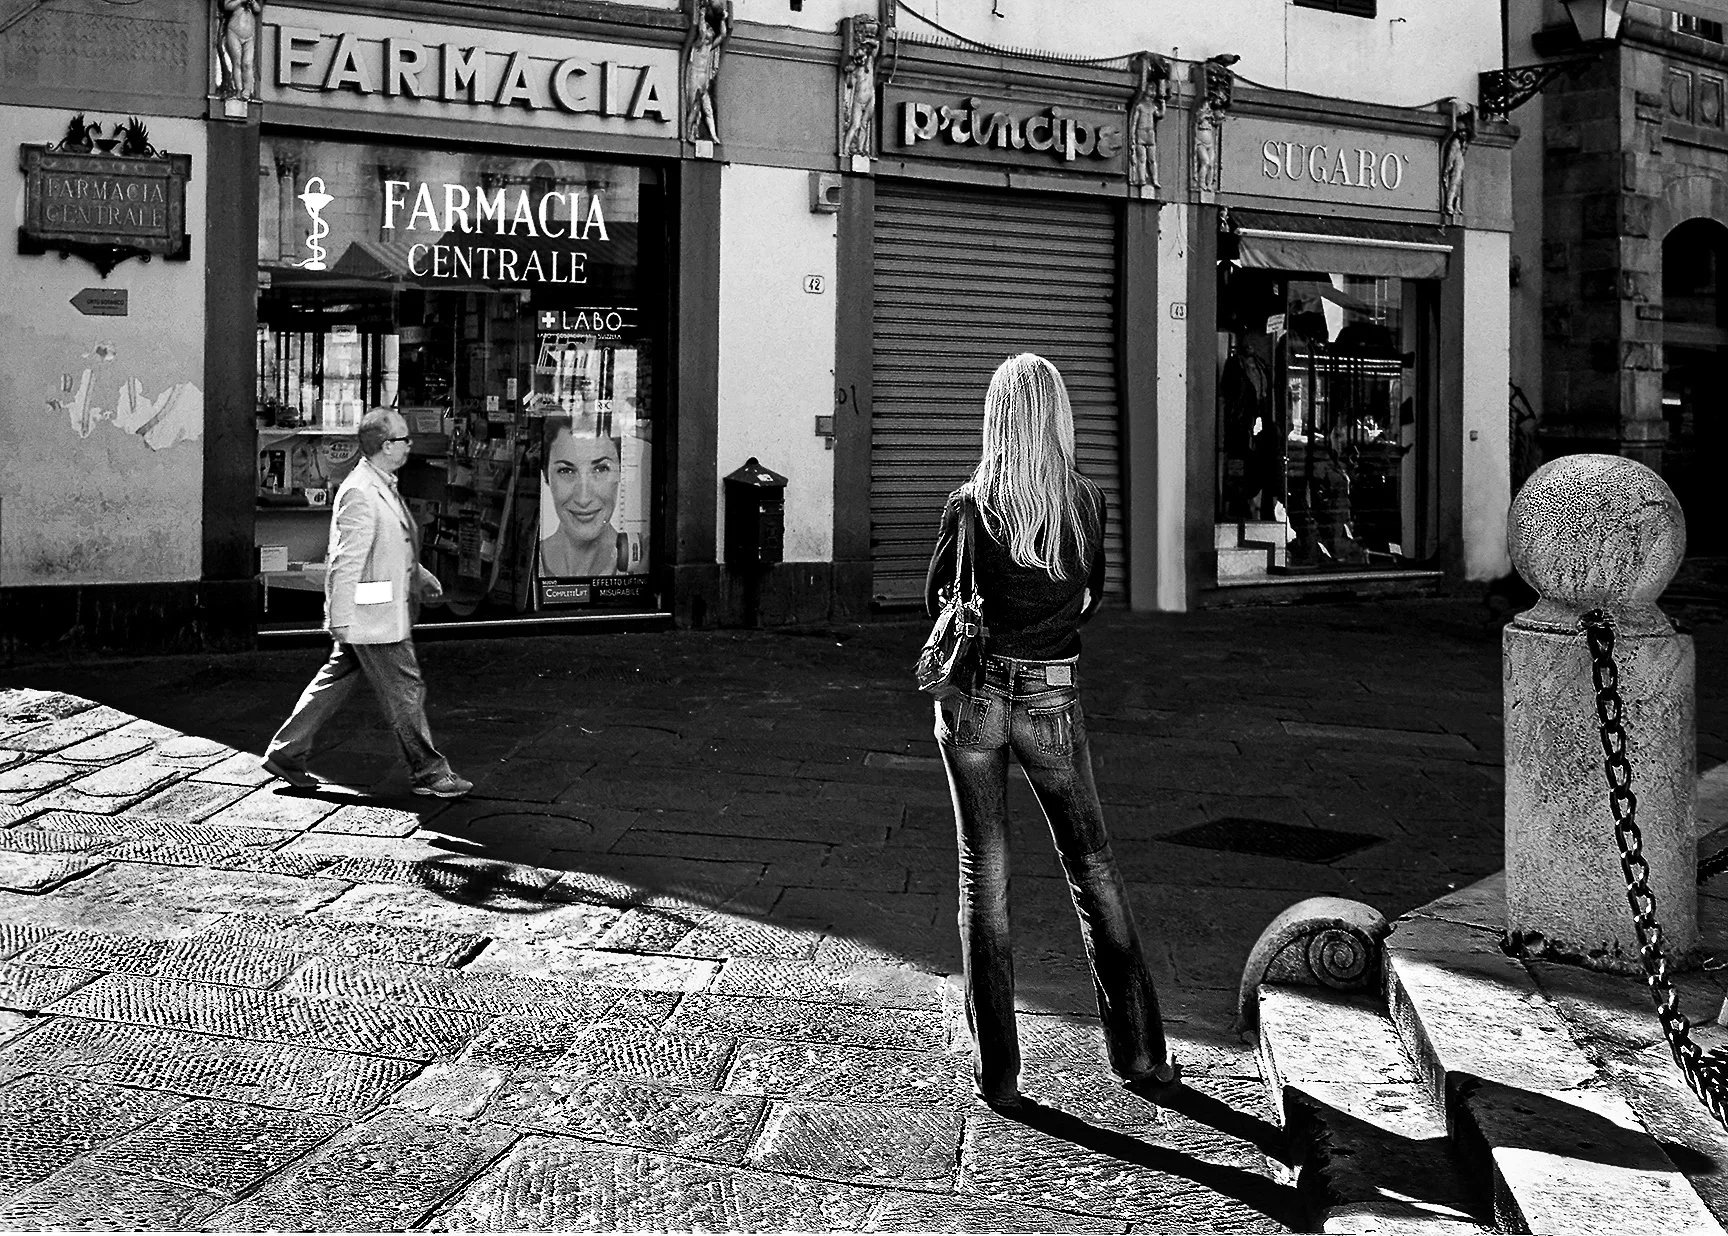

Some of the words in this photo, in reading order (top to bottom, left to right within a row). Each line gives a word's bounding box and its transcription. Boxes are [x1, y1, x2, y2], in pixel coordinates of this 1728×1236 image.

[276, 25, 671, 122] FARMACIA
[46, 177, 163, 203] FARMACIA
[46, 204, 161, 227] CENTRALE
[382, 180, 610, 241] FARMACIA
[407, 243, 588, 284] CENTRALE
[808, 278, 820, 291] 42
[562, 310, 622, 331] LABO
